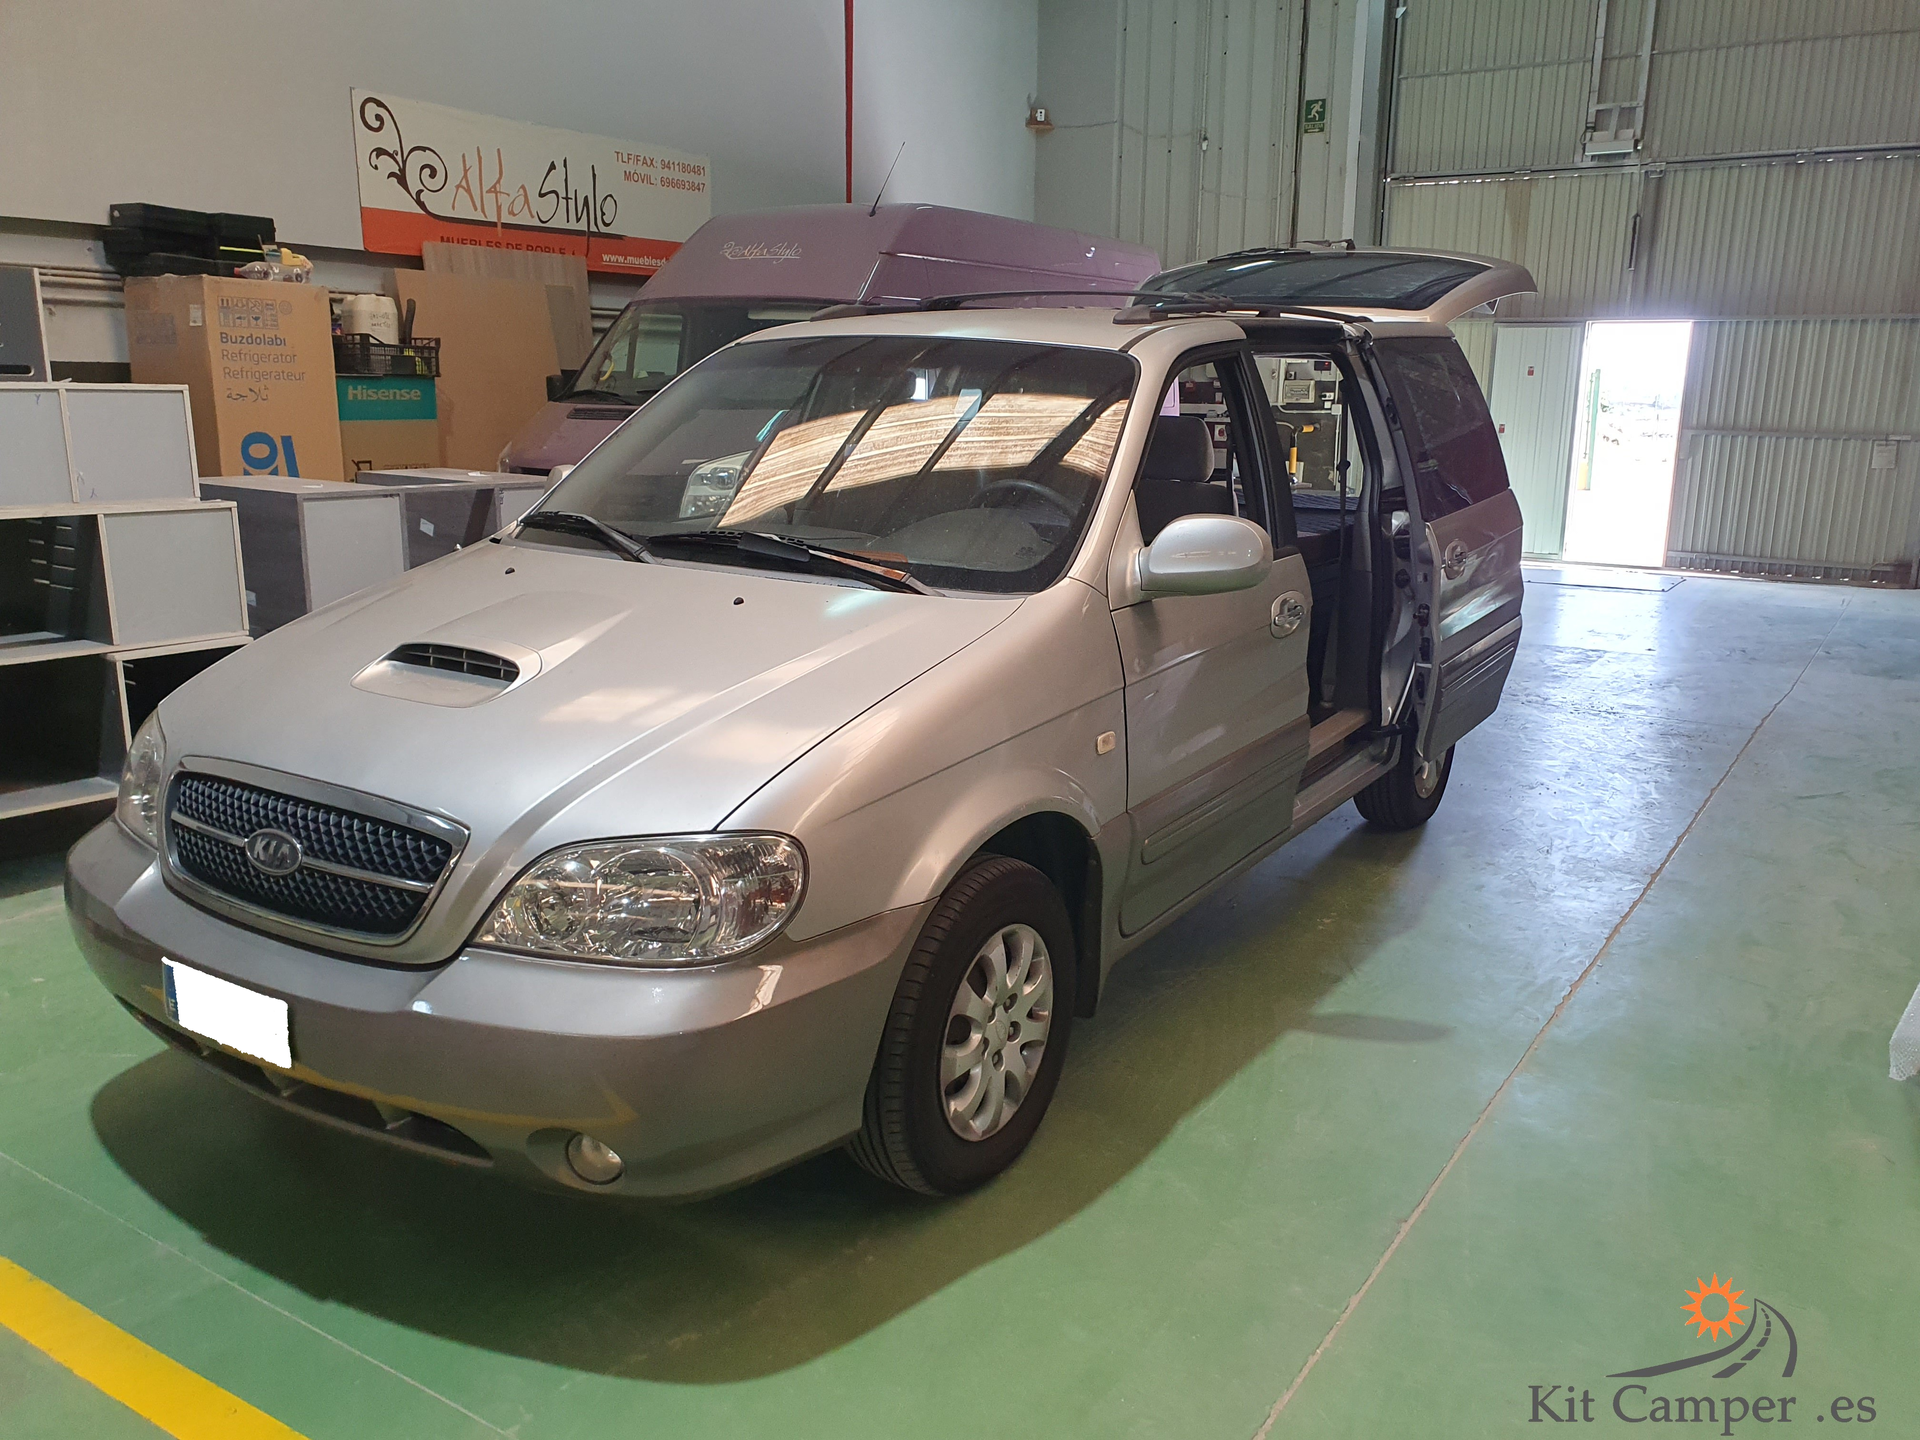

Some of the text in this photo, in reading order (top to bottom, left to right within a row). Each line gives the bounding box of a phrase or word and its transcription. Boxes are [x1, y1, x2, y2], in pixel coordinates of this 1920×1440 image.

[614, 151, 706, 177] TLF/FAX: 941180481
[623, 170, 706, 193] MÓVIL: 696693847
[221, 349, 297, 365] Refrigerator
[223, 367, 306, 383] Refrigerateur
[226, 385, 269, 402] ثلاجة
[347, 384, 422, 401] Hisense
[253, 835, 292, 865] KIA
